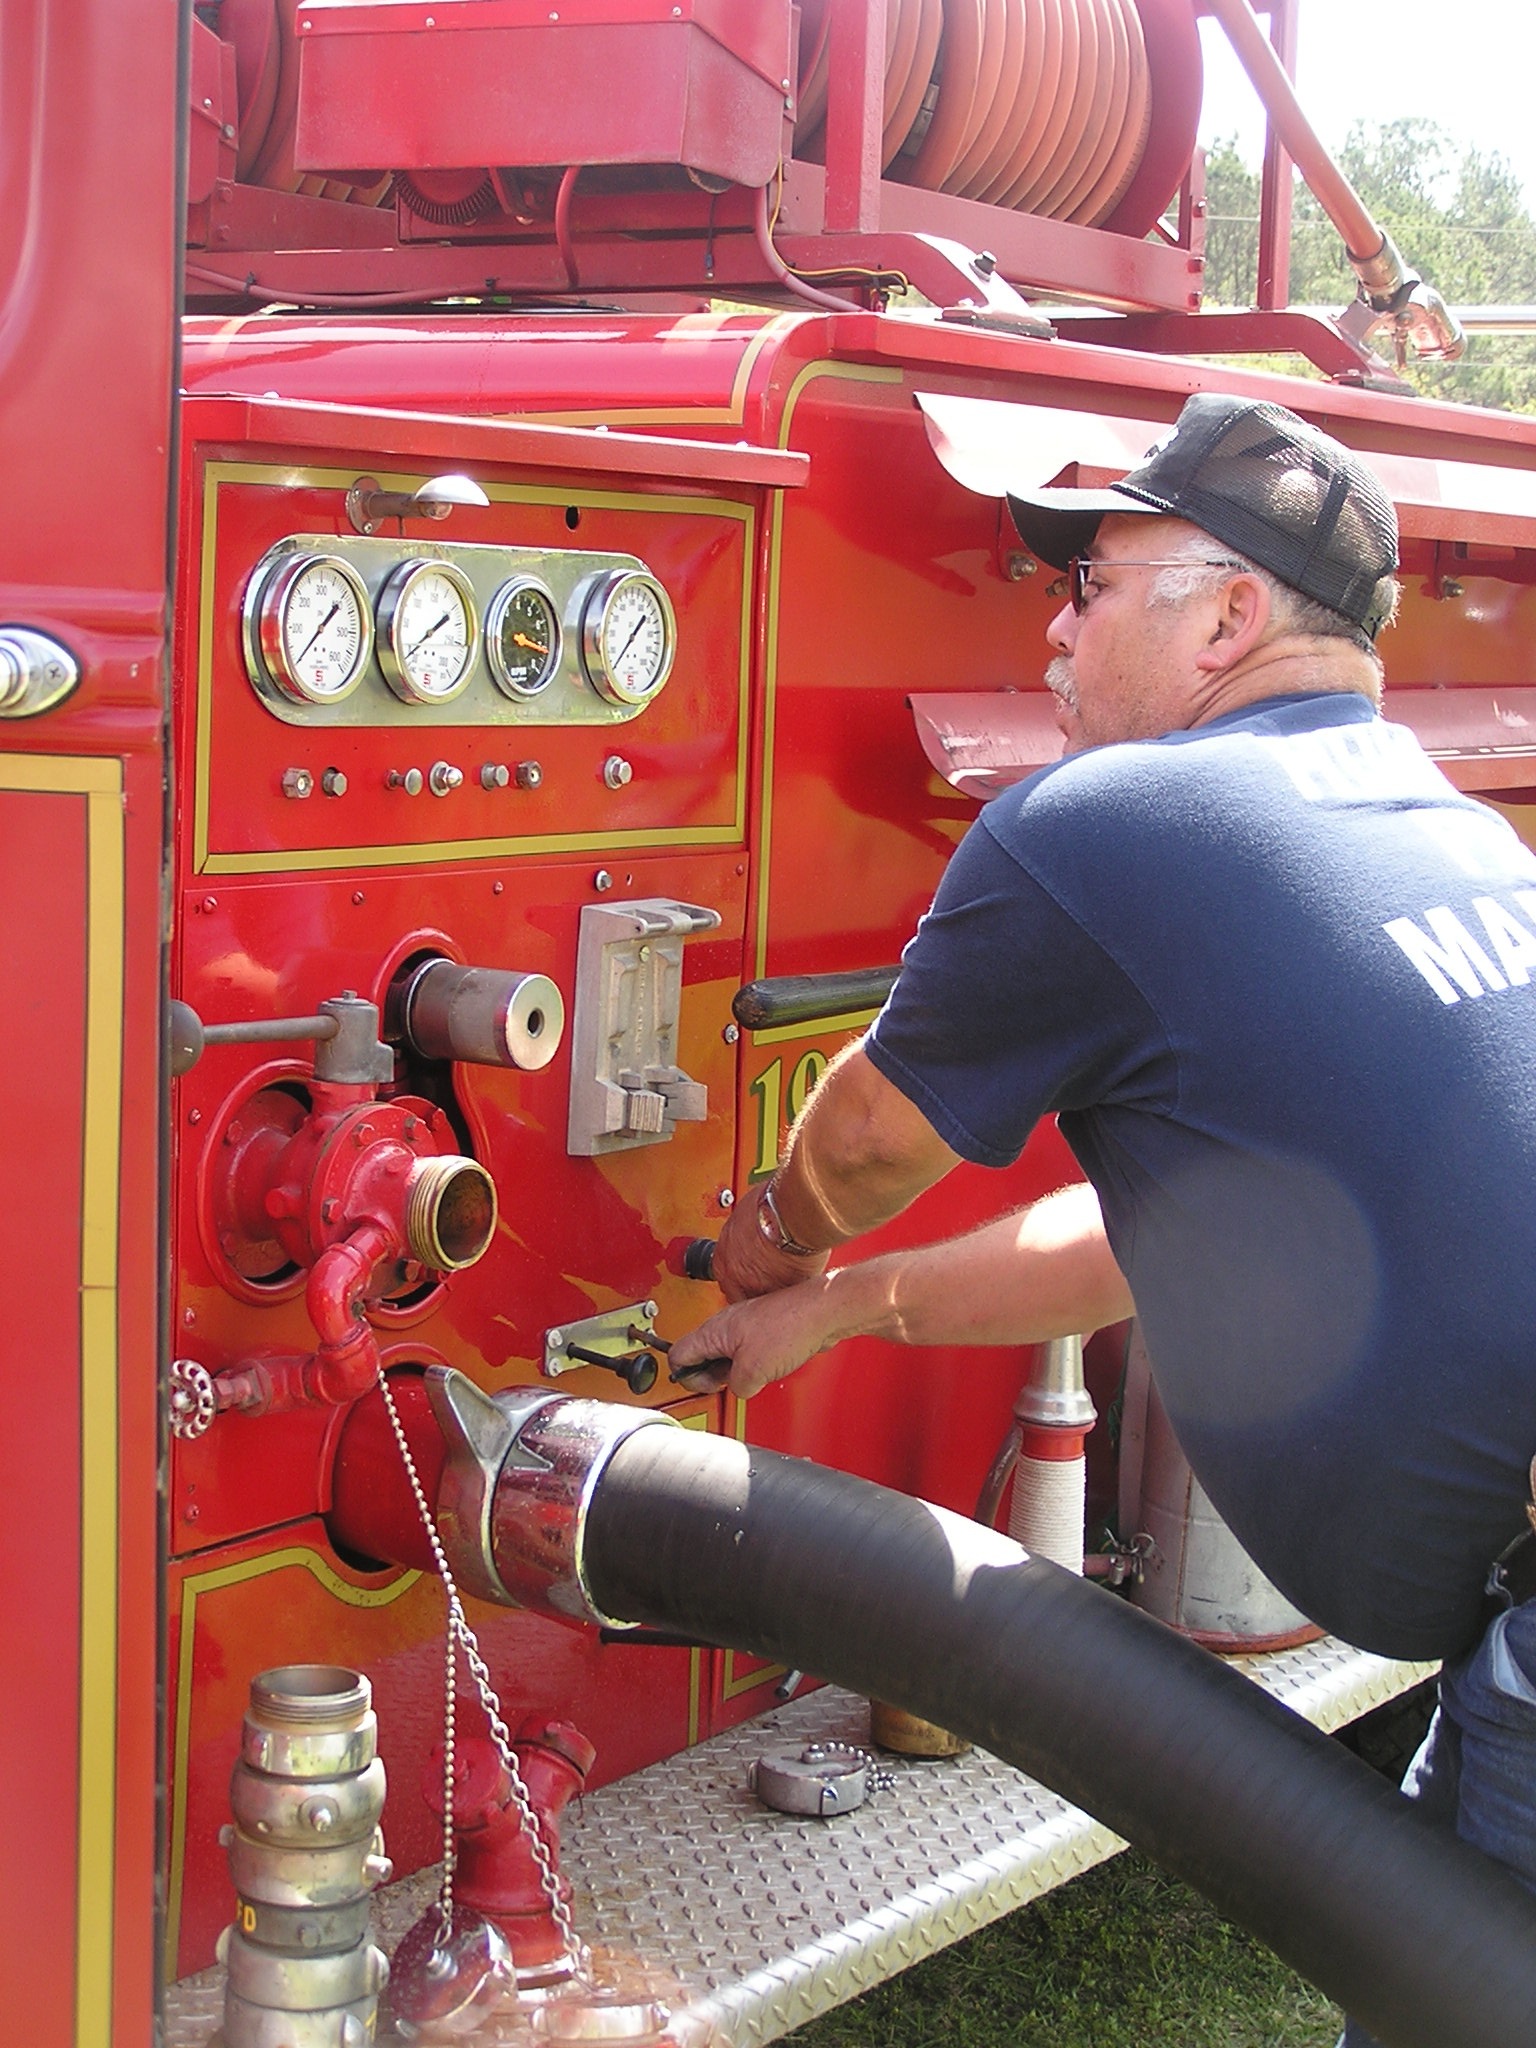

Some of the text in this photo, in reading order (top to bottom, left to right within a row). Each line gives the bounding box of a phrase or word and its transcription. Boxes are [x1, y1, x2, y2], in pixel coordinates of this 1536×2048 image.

[315, 584, 328, 596] 300
[298, 597, 311, 608] 200
[291, 623, 303, 634] 100
[336, 627, 349, 638] 500
[329, 651, 341, 662] 600
[1381, 889, 1536, 1006] MA
